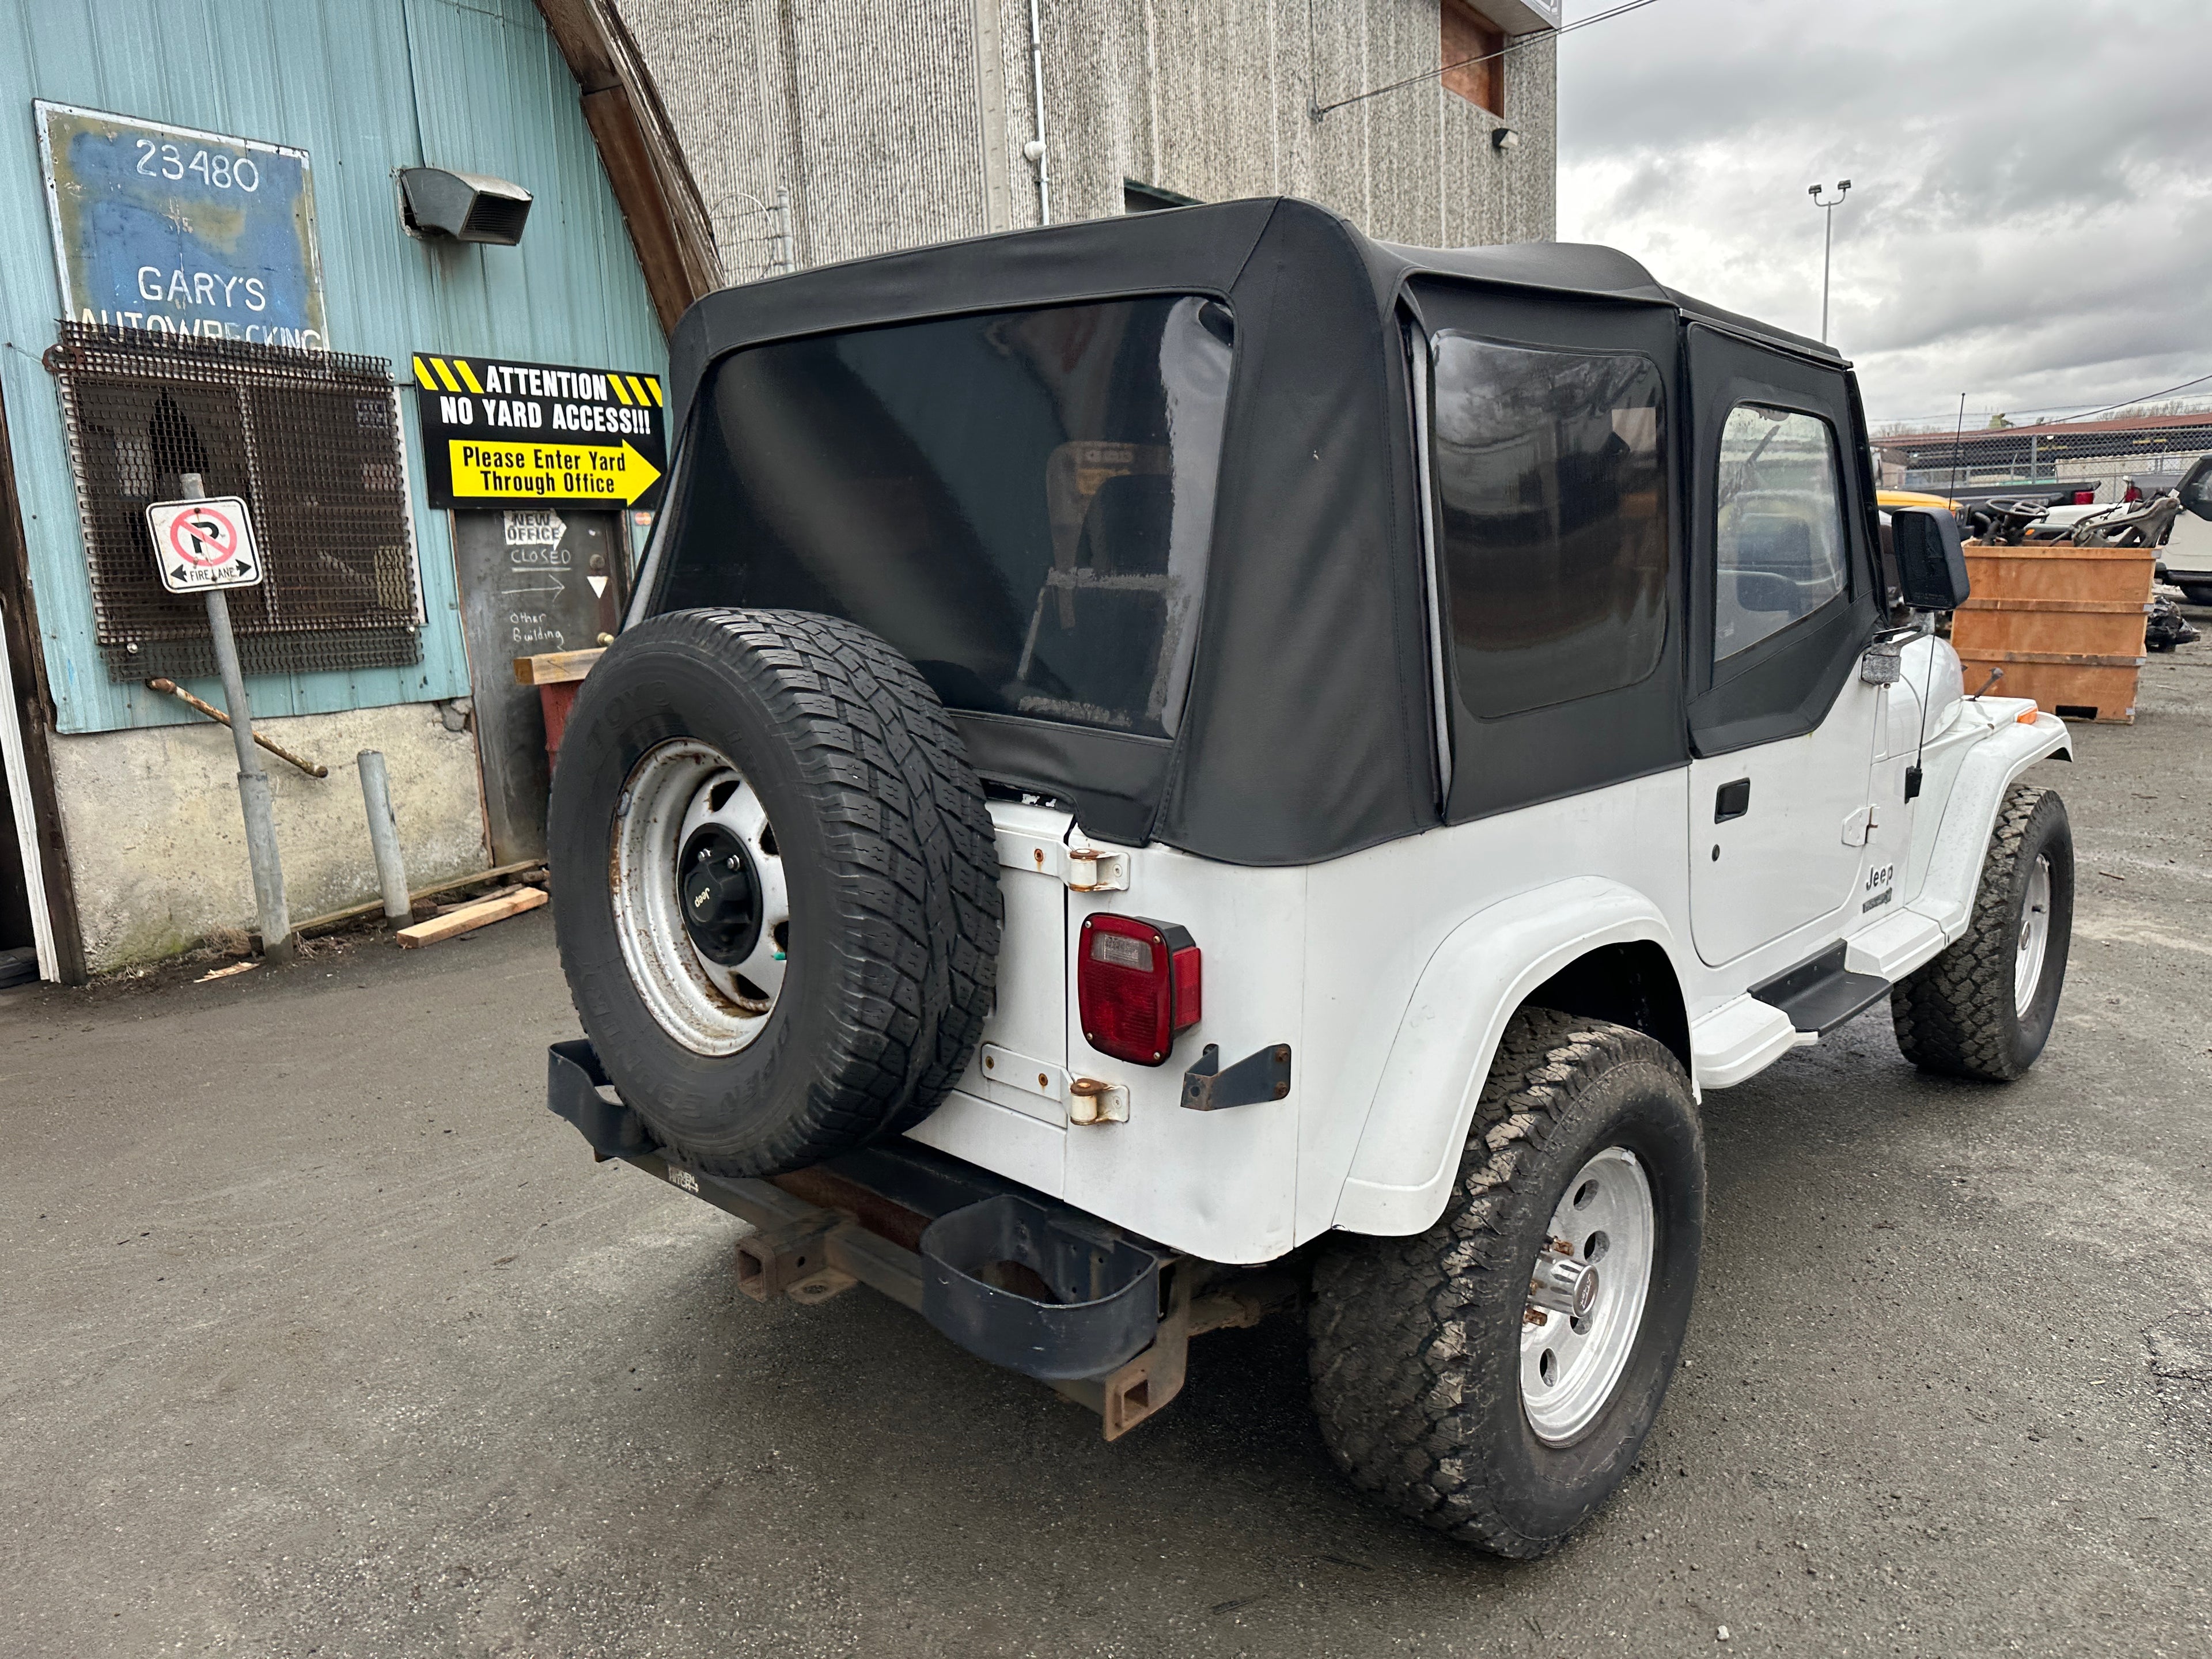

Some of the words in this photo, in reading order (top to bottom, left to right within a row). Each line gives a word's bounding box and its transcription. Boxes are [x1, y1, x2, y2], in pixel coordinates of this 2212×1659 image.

[135, 138, 259, 192] 23480
[137, 266, 266, 311] GARY'S
[486, 365, 608, 401] ATTENTION
[440, 396, 474, 425] NO
[482, 399, 542, 429] YARD
[552, 403, 651, 434] ACCESS!!!
[463, 446, 525, 468] Please
[533, 449, 581, 470] Enter
[588, 451, 626, 472] Yard
[480, 471, 555, 495] Through
[563, 472, 615, 493] Office
[512, 513, 548, 526] NEW
[507, 525, 561, 541] OFFICE
[511, 548, 571, 565] CLOSED
[190, 569, 209, 581] FIRE
[513, 627, 565, 646] Building
[1866, 865, 1893, 891] Jeep
[694, 887, 710, 908] Jeep
